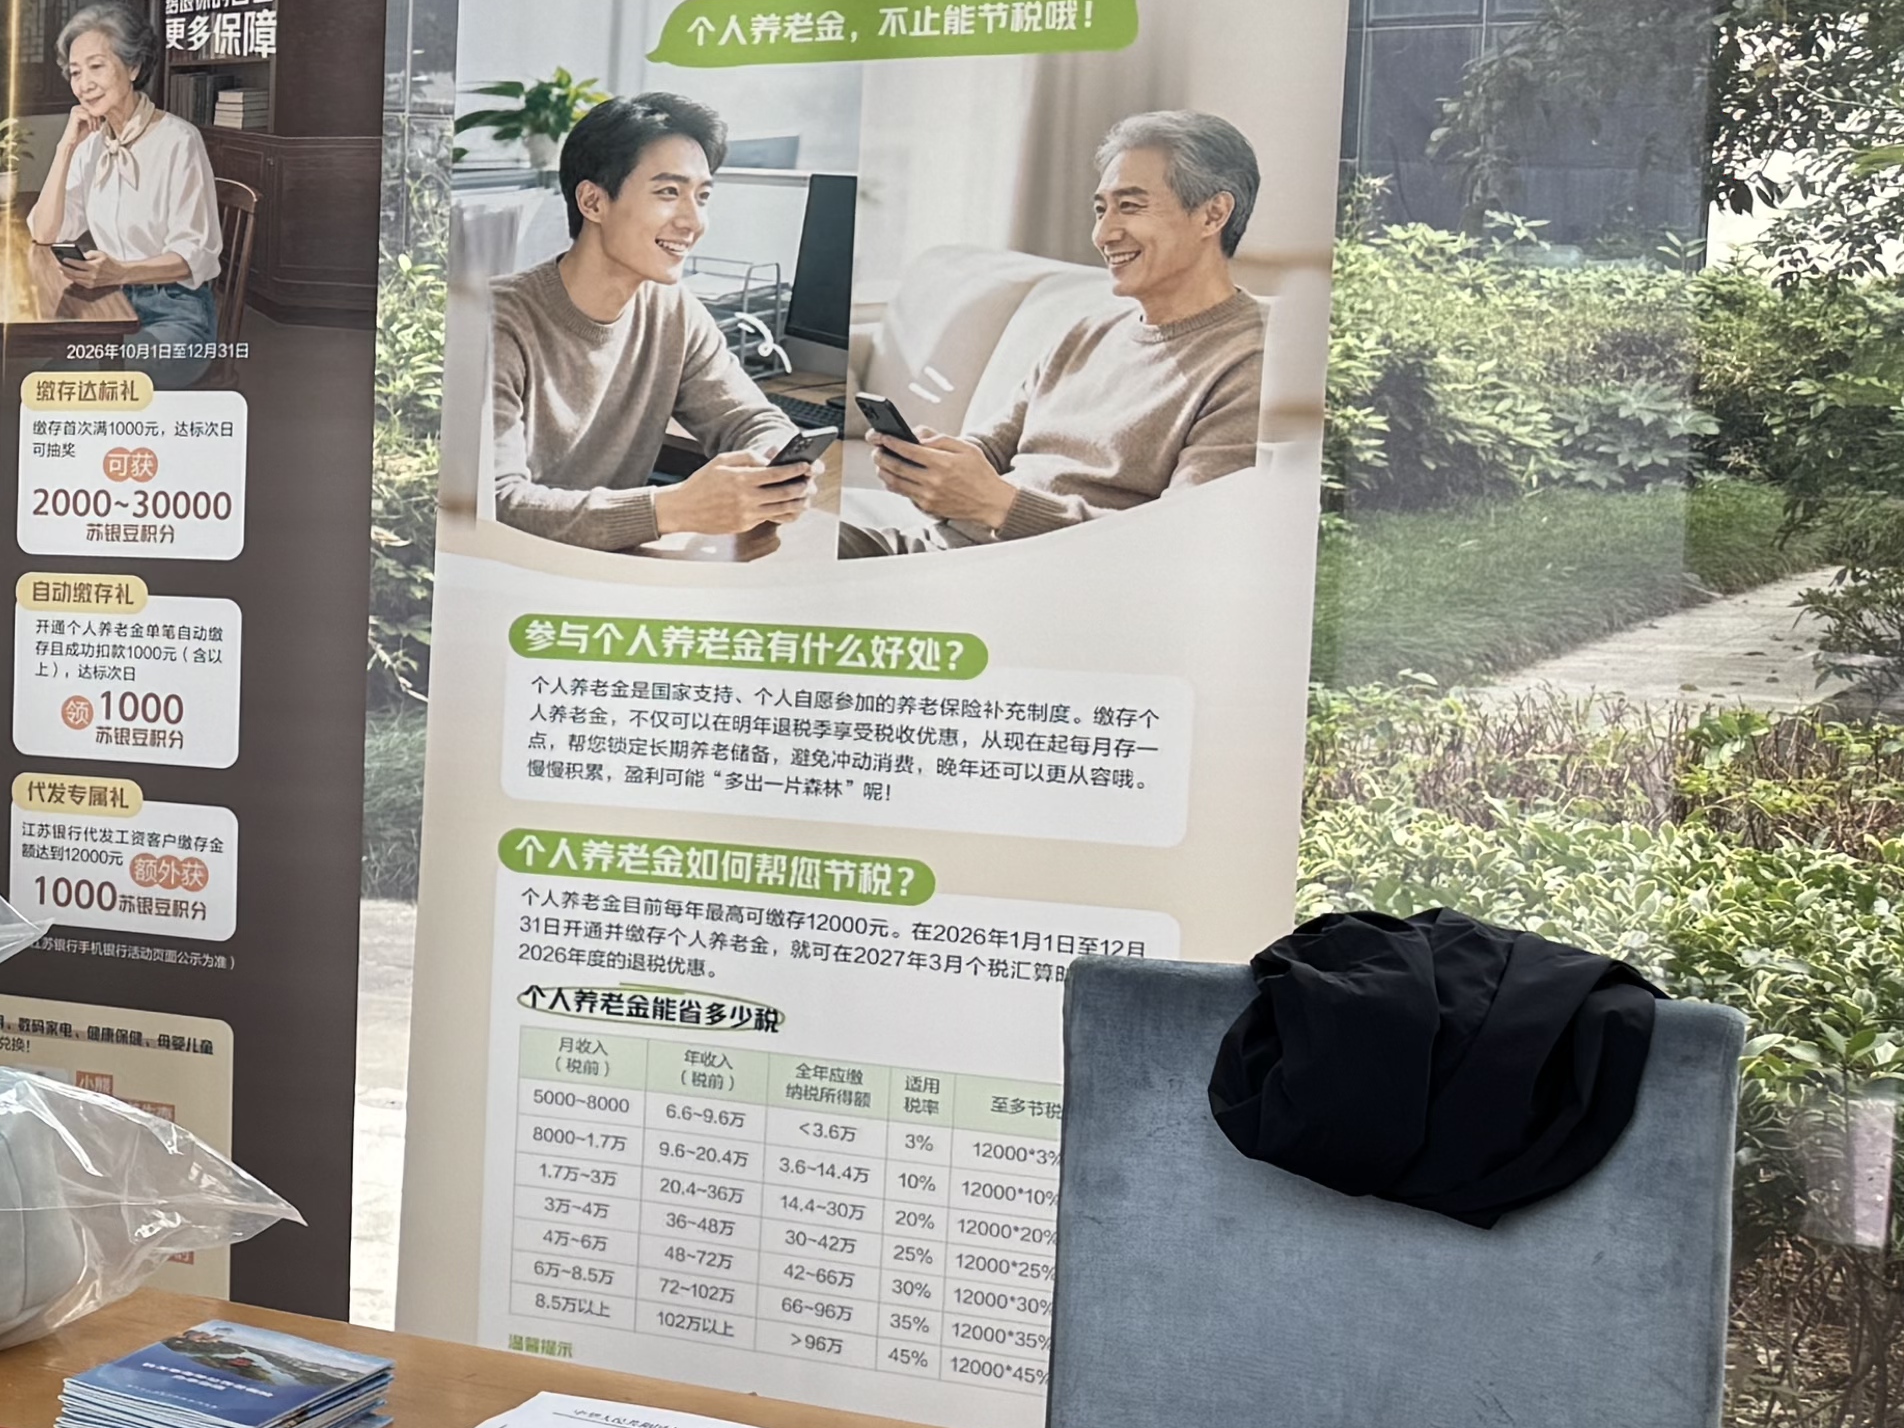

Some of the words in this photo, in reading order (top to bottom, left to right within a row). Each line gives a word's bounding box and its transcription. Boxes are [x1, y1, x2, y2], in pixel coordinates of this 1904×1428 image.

[165, 9, 278, 59] 更多保障
[66, 341, 250, 360] 2026年10月1日至12月31日
[36, 379, 139, 402] 缴存达标礼
[32, 420, 234, 438] 缴存首次满1000元，达标次日
[32, 442, 76, 458] 可抽奖
[107, 452, 154, 478] 可获
[32, 487, 232, 521] 2000~30000
[86, 523, 175, 544] 苏银豆积分
[32, 581, 135, 605] 自动缴存礼
[35, 618, 224, 643] 开通个人养老金单笔自动缴
[524, 619, 964, 671] 参与个人养老金有什么好处？
[65, 699, 90, 725] 领
[100, 690, 185, 725] 1000
[530, 676, 1160, 729] 个人养老金是国家支持、个人自愿参加的养老保险补充制度。缴存个
[95, 725, 184, 750] 苏银豆积分
[529, 703, 1159, 759] 人养老金，不仅可以在明年退税季享受税收优惠，从现在起每月存一
[527, 731, 1148, 791] 点，帮您锁定长期养老储备，避免冲动消费，晚年还可以更从容哦。
[27, 780, 130, 809] 代发专属礼
[21, 821, 224, 854] 江苏银行代发工资客户缴存金
[21, 843, 124, 866] 额达到12000元
[515, 834, 914, 897] 个人养老金如何帮您节税？
[134, 858, 205, 887] 额外获
[521, 886, 1146, 959] 个人养老金目前每年最高可缴存12000元。在2026年1月1日至12月
[517, 943, 718, 978] 2026年度的退税优惠。
[525, 985, 780, 1033] 个人养老金能省多少税
[559, 1036, 609, 1057] 月收入
[684, 1049, 734, 1070] 年收入
[795, 1062, 864, 1086] 全年应缴
[904, 1074, 941, 1095] 适用
[785, 1083, 872, 1109] 纳税所得额
[903, 1095, 940, 1115] 税率
[533, 1088, 630, 1114] 5000~8000
[665, 1103, 746, 1128] 6.6~9.6万
[904, 1134, 934, 1152] 3%
[532, 1127, 627, 1153] 8000~1.7万
[658, 1141, 749, 1169] 9.6~20.4万
[779, 1156, 871, 1184] 3.6~14.4万
[898, 1173, 936, 1192] 10%
[539, 1162, 618, 1188] 1.7万~3万
[659, 1177, 744, 1205] 20.4~36万
[780, 1194, 867, 1221] 14.4~30万
[895, 1210, 935, 1230] 20%
[544, 1197, 609, 1220] 3万~4万
[665, 1212, 735, 1237] 36~48万
[784, 1230, 857, 1255] 30~42万
[892, 1244, 934, 1265] 25%
[542, 1229, 608, 1253] 4万~6万
[664, 1245, 734, 1270] 48~72万
[783, 1263, 855, 1289] 42~66万
[891, 1279, 932, 1299] 30%
[533, 1259, 615, 1286] 6万~8.5万
[659, 1277, 735, 1304] 72~102万
[781, 1297, 853, 1322] 66~96万
[889, 1313, 930, 1333] 35%
[535, 1292, 611, 1318] 8.5万以上
[657, 1310, 735, 1337] 102万以上
[887, 1347, 928, 1368] 45%
